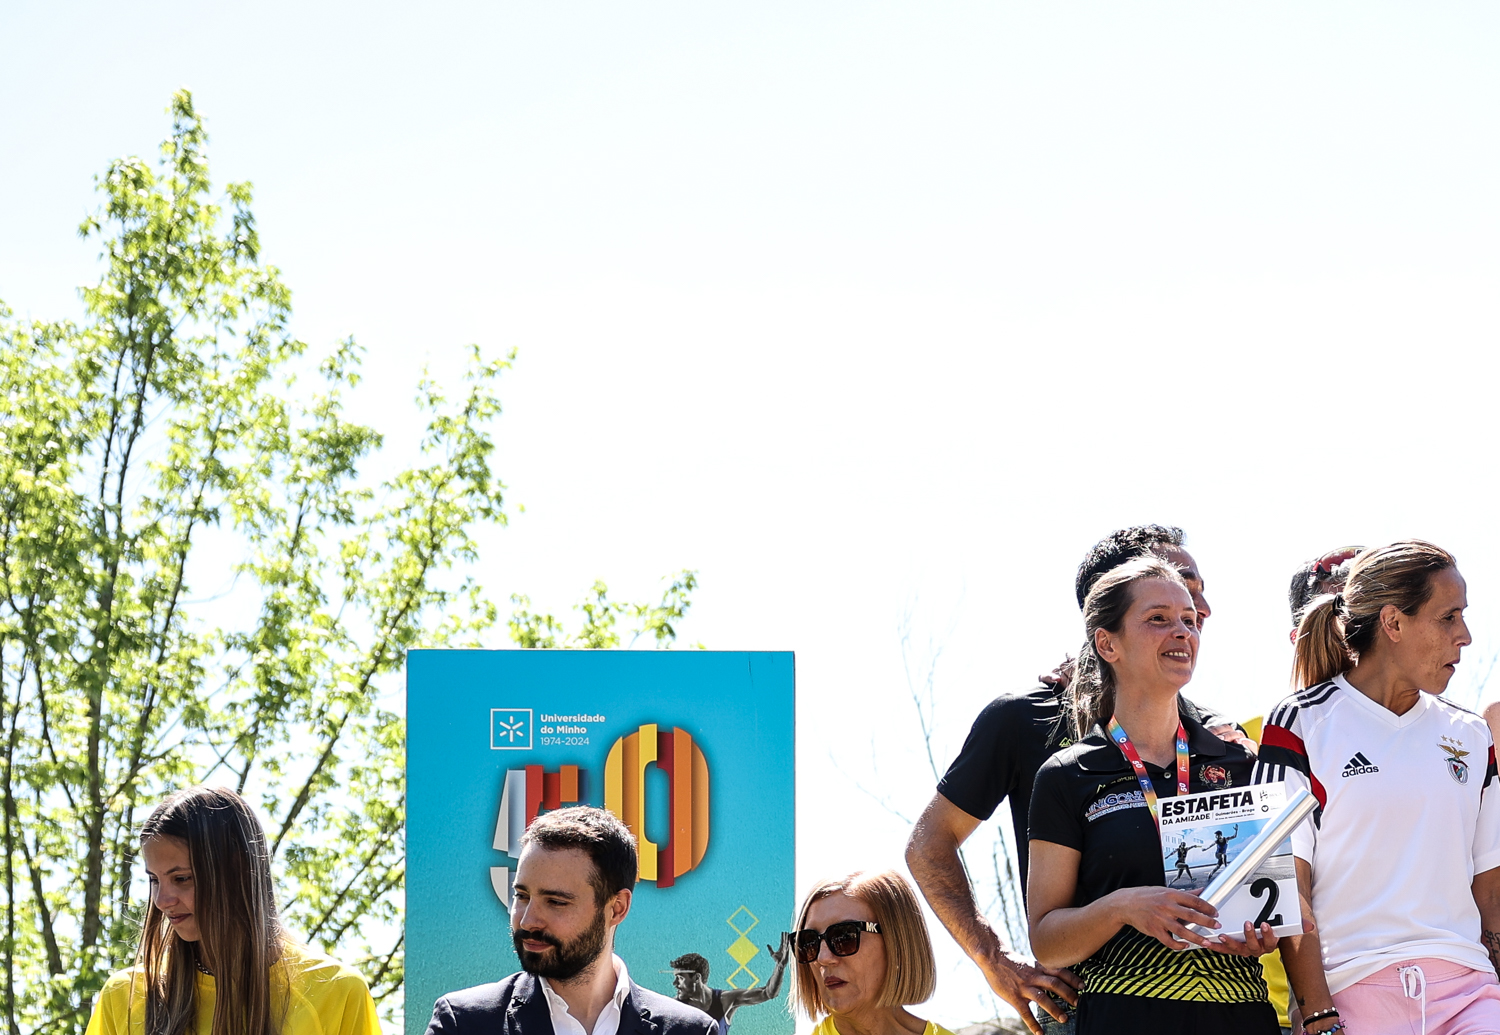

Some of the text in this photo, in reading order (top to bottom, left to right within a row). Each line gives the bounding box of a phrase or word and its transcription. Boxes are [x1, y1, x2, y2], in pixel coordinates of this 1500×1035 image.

[540, 714, 606, 723] Universidade
[540, 725, 587, 734] do Minho
[540, 737, 590, 746] 1974-2024
[1341, 765, 1379, 778] adidas
[1161, 790, 1254, 818] ESTAFETA
[1175, 813, 1210, 824] AMIZADE
[1250, 877, 1284, 930] 2
[866, 921, 879, 933] MK
